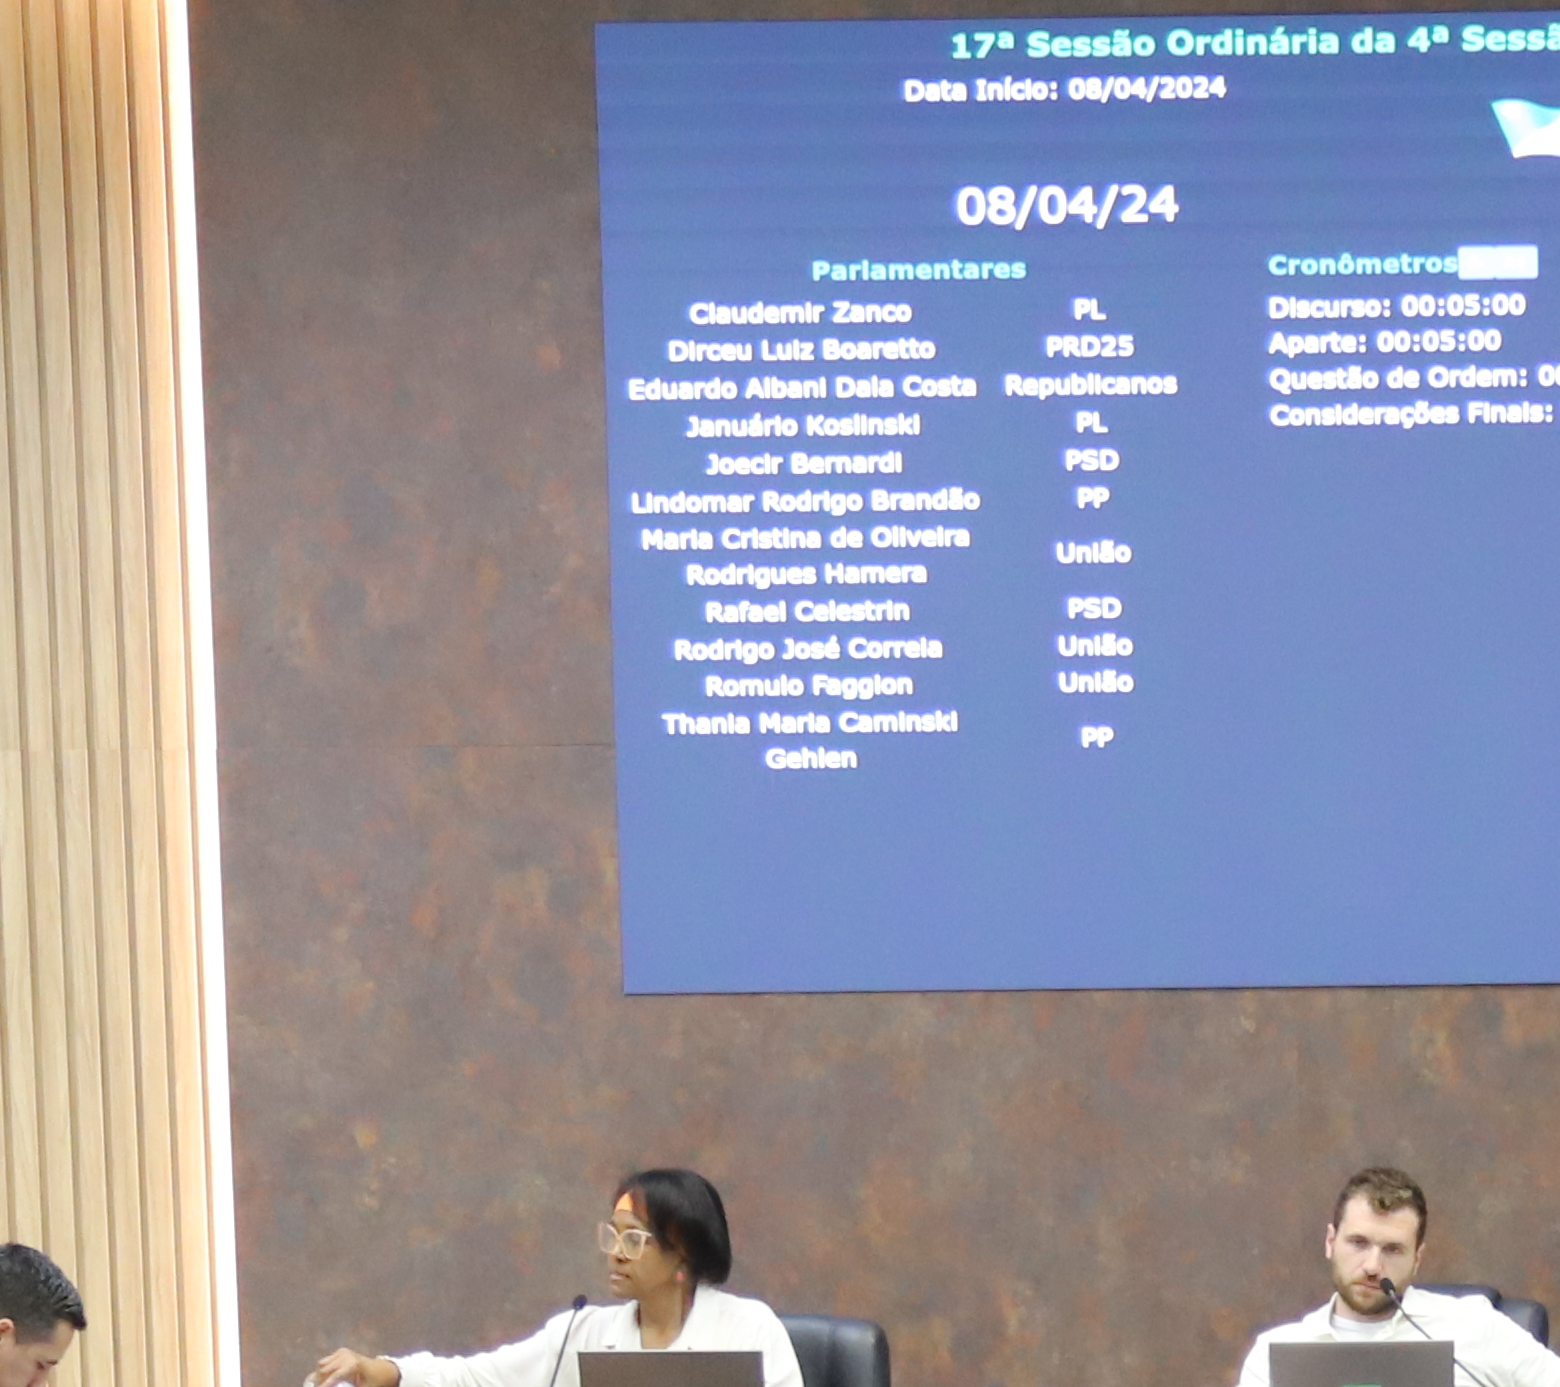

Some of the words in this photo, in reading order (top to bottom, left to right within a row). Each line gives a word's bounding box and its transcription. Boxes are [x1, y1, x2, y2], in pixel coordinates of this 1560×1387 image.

[952, 31, 1014, 59] 17ª
[1027, 29, 1156, 58] Sessão
[1166, 26, 1339, 56] Ordinária
[1351, 26, 1395, 54] da
[1407, 25, 1449, 53] 4ª
[904, 79, 967, 102] Data
[975, 76, 1058, 101] Início:
[1068, 75, 1227, 103] 08/04/2024
[957, 184, 1179, 231] 08/04/24
[812, 259, 1027, 281] Parlamentares
[1268, 253, 1458, 278] Cronômetros
[689, 301, 825, 325] Claudemir
[832, 300, 912, 323] Zanco
[1074, 298, 1107, 320] PL
[1268, 296, 1391, 319] Discurso:
[1401, 293, 1526, 317] 00:05:00
[668, 340, 753, 362] Dirceu
[761, 339, 815, 361] Luiz
[822, 337, 936, 361] Boaretto
[1046, 334, 1134, 358] PRD25
[1268, 331, 1367, 359] Aparte:
[1376, 328, 1502, 353] 00:05:00
[628, 376, 738, 401] Eduardo
[744, 376, 827, 399] Albani
[835, 375, 894, 399] Dala
[902, 375, 977, 398] Costa
[1005, 372, 1178, 401] Republicanos
[1269, 365, 1379, 395] Questão
[1386, 366, 1420, 389] de
[1427, 364, 1527, 388] Ordem:
[686, 412, 799, 438] Januário
[806, 412, 921, 437] Koslinski
[1076, 411, 1109, 433] PL
[1269, 400, 1460, 429] Considerações
[1468, 401, 1553, 424] Finais:
[706, 453, 784, 476] Joecir
[790, 450, 903, 475] Bernardi
[1065, 448, 1120, 471] PSD
[631, 490, 755, 514] Lindomar
[762, 489, 863, 516] Rodrigo
[871, 486, 981, 511] Brandão
[1077, 486, 1110, 509] PP
[641, 528, 713, 551] Maria
[721, 527, 822, 550] Cristina
[829, 526, 863, 549] de
[870, 525, 970, 548] Oliveira
[1056, 539, 1132, 564] União
[686, 562, 817, 590] Rodrigues
[824, 562, 927, 584] Hamera
[705, 600, 787, 623] Rafael
[794, 599, 910, 622] Celestrin
[1068, 596, 1122, 619] PSD
[674, 638, 775, 665] Rodrigo
[782, 635, 841, 660] José
[847, 636, 943, 659] Correia
[1058, 632, 1133, 657] União
[705, 674, 805, 697] Romulo
[812, 674, 913, 700] Faggion
[1058, 669, 1134, 693] União
[661, 712, 751, 735] Thania
[759, 712, 831, 734] Maria
[838, 710, 958, 733] Caminski
[1081, 726, 1114, 748] PP
[765, 746, 857, 769] Gehlen
